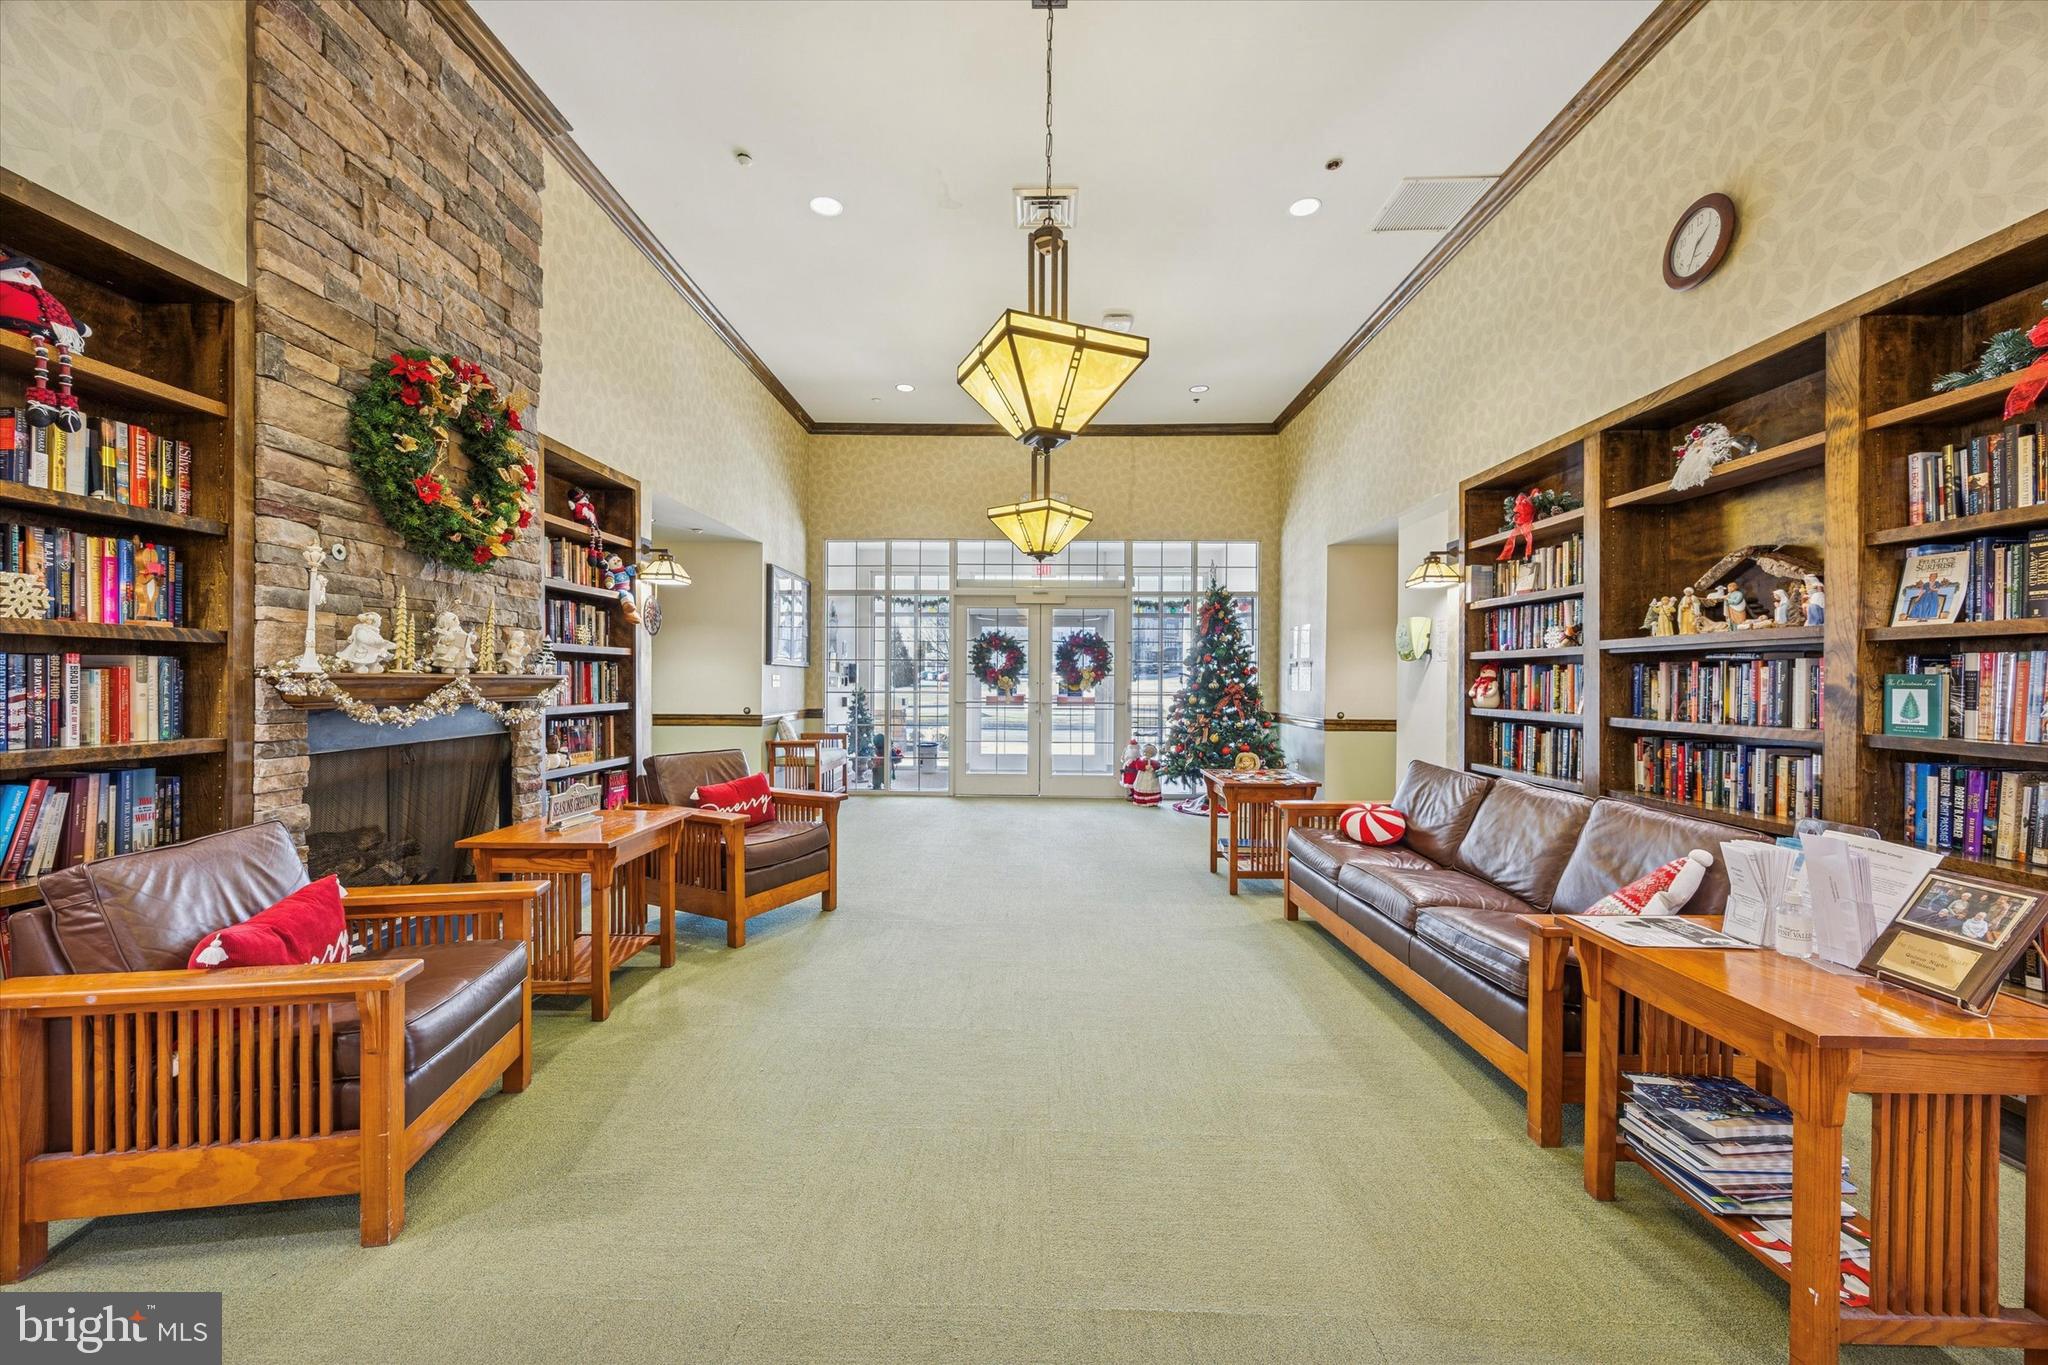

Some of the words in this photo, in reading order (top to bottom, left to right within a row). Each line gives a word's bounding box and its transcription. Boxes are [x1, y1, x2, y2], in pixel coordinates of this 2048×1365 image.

[136, 434, 146, 480] NOCTURNAL
[165, 440, 174, 461] Daniel
[178, 448, 192, 474] Silva
[165, 461, 174, 476] Silva
[1911, 472, 1919, 490] BOX
[178, 487, 188, 514] ORDER
[1036, 564, 1052, 577] EXIT
[1915, 562, 1954, 572] SURPRISE
[2029, 561, 2038, 586] WORLD
[2037, 550, 2048, 585] WINTER
[34, 658, 42, 674] BRAD
[50, 655, 60, 677] BRAD
[70, 665, 78, 684] BRAD
[34, 675, 42, 697] TAYLOR
[50, 678, 60, 700] THOR
[70, 686, 78, 704] THOR
[34, 700, 42, 715] RING
[34, 725, 42, 739] FIRE
[11, 790, 24, 812] Jennifer
[574, 792, 599, 811] GREETINGS
[1954, 786, 1965, 808] ROBERT
[4, 813, 16, 832] Weiner
[1939, 816, 1949, 843] PASSAGE
[1953, 814, 1964, 838] PARKER
